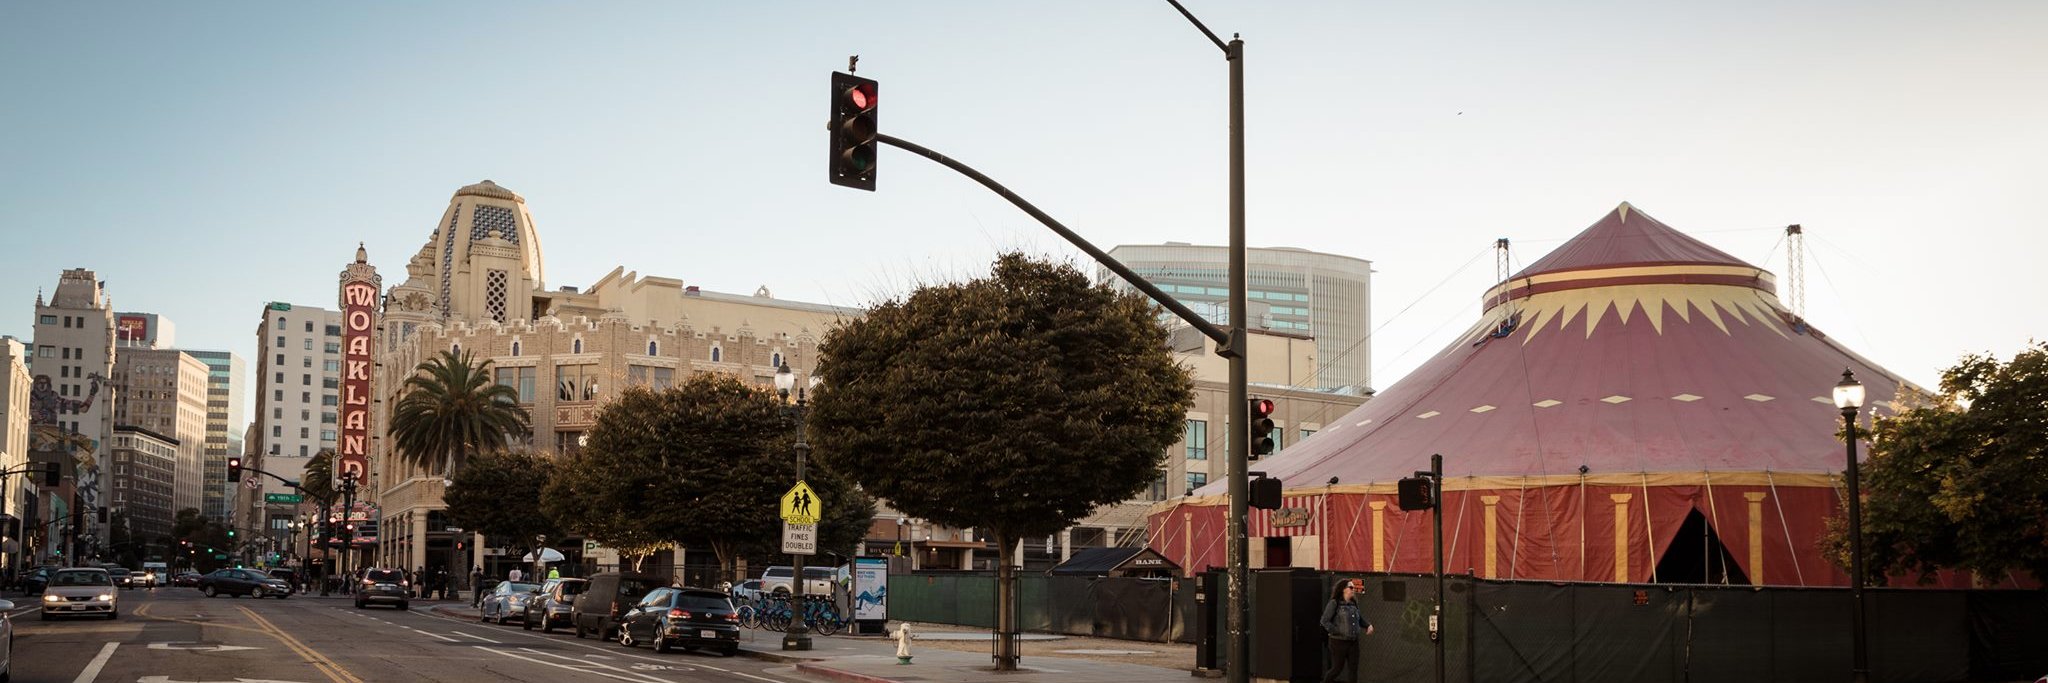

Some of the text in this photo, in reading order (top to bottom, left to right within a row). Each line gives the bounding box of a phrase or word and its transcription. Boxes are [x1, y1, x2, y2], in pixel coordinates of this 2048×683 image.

[345, 284, 376, 307] FOX
[344, 311, 370, 481] OAKLAND
[789, 516, 812, 524] SCHOOL
[788, 523, 813, 532] TRAFFIC
[790, 533, 809, 541] FINES
[785, 541, 814, 550] DOUBLED
